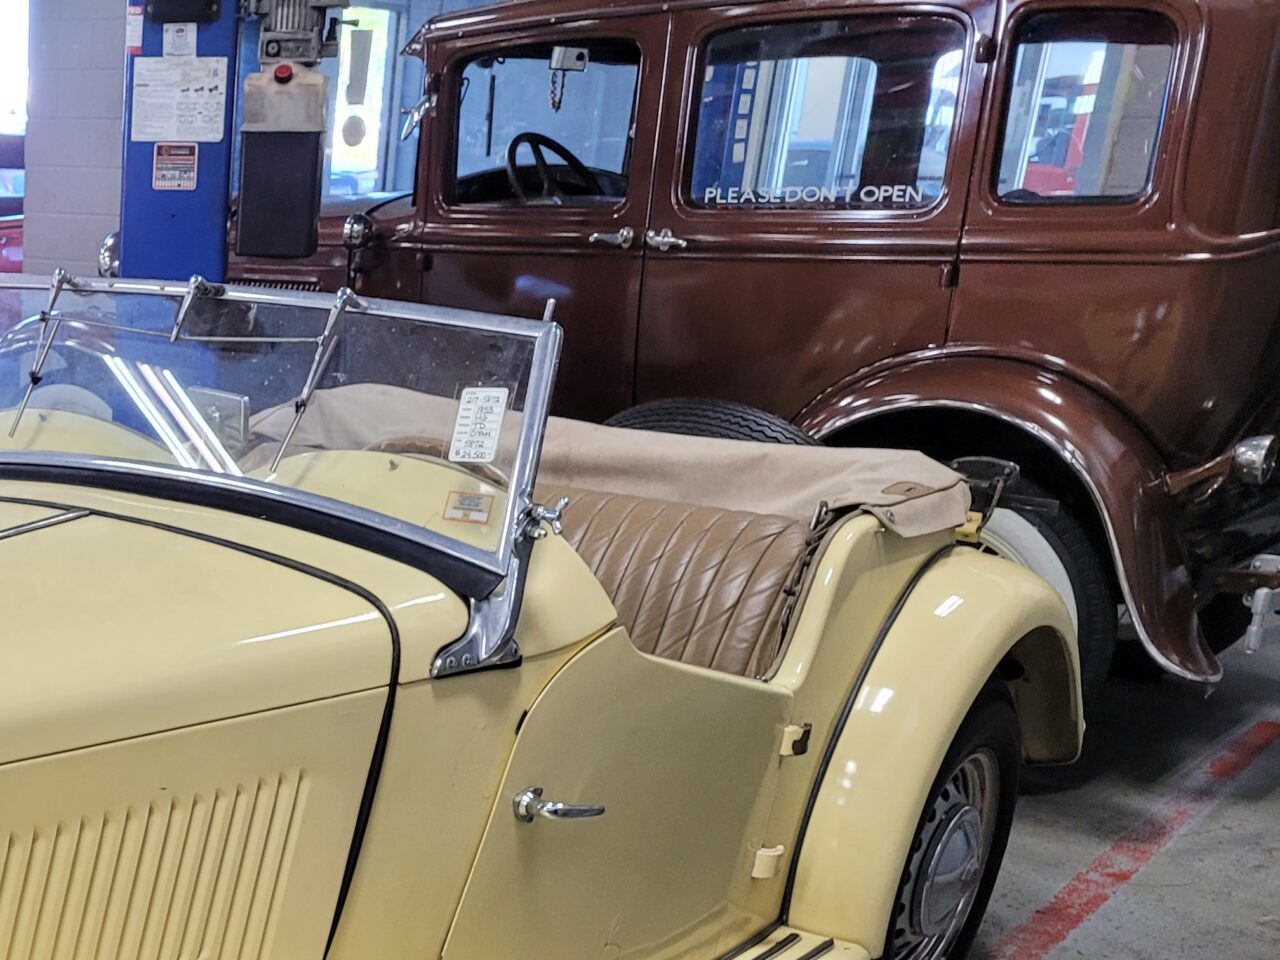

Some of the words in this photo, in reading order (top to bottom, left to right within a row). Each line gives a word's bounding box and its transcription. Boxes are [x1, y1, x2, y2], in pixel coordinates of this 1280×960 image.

[704, 186, 781, 204] PLEASE
[783, 185, 857, 203] DON'T
[860, 184, 923, 203] OPEN
